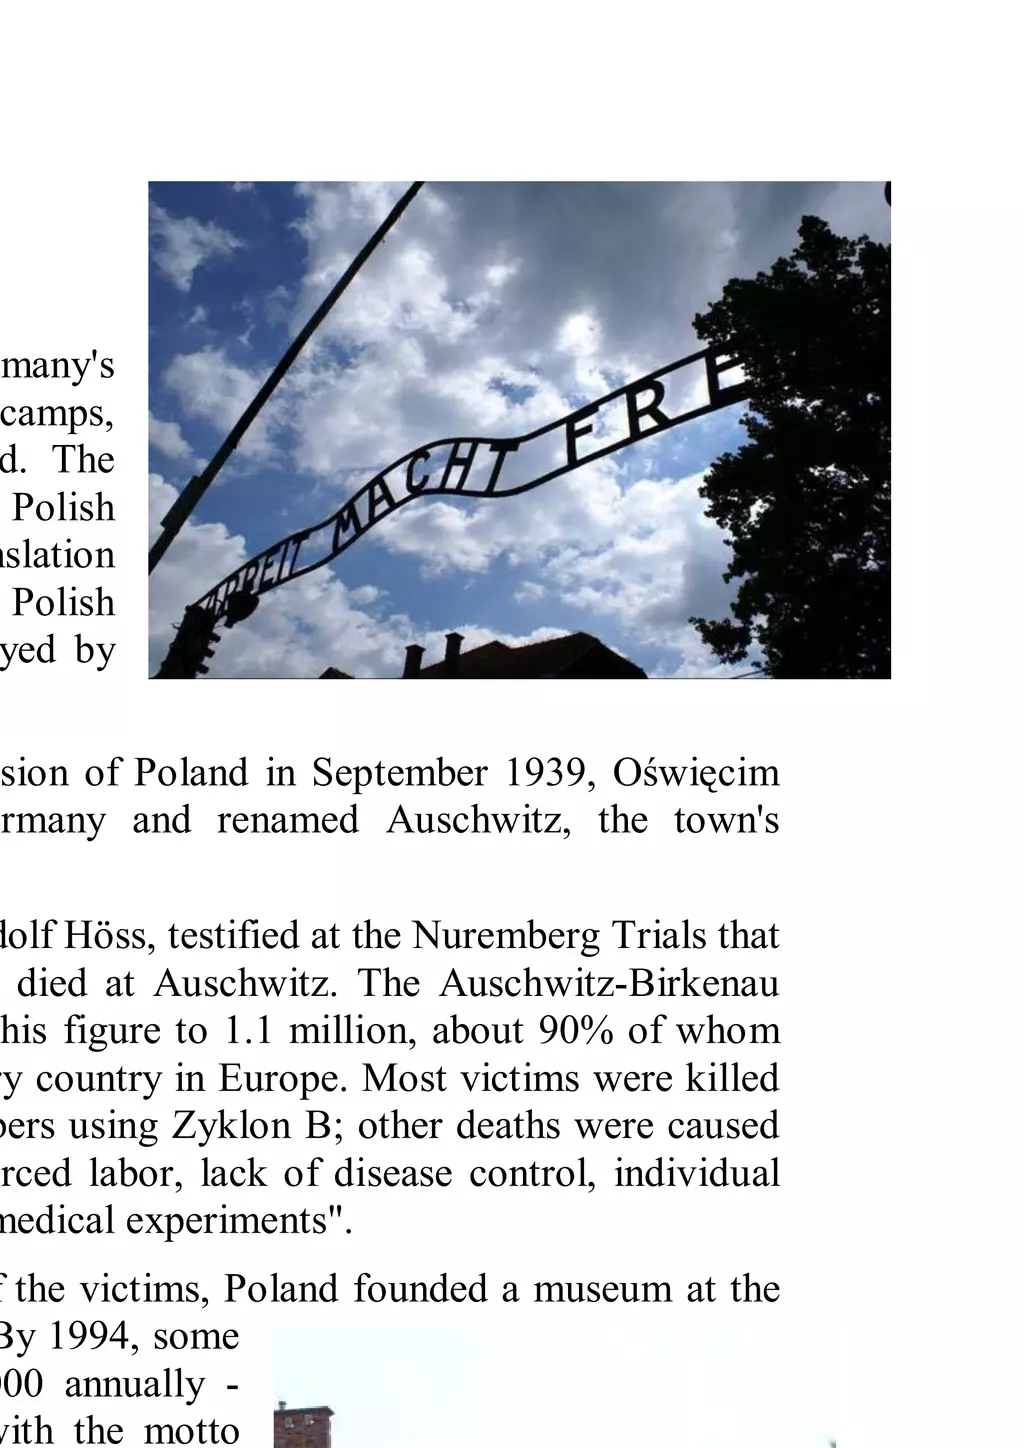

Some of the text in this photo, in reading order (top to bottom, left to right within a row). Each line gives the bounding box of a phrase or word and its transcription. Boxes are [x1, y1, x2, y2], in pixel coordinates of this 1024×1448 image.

[0, 405, 113, 435] camps,
[51, 443, 115, 474] The
[331, 437, 522, 557] MACHT
[565, 346, 752, 469] FRE
[74, 633, 117, 672] by
[85, 756, 125, 787] of
[134, 756, 249, 787] Poland
[266, 756, 297, 787] in
[313, 756, 489, 795] September
[508, 756, 596, 793] 1939,
[613, 756, 781, 794] Oświęcim
[63, 919, 155, 956] Höss,
[167, 918, 300, 950] testified
[311, 923, 341, 950] at
[351, 918, 401, 950] the
[411, 918, 601, 958] Nuremberg
[611, 918, 707, 950] Trials
[717, 918, 780, 950] that
[63, 1013, 161, 1053] figure
[175, 1018, 208, 1045] to
[227, 1014, 271, 1045] 1.1
[289, 1013, 416, 1051] million,
[432, 1013, 524, 1045] about
[539, 1014, 614, 1045] 90%
[628, 1013, 668, 1045] of
[675, 1013, 782, 1045] whom
[68, 1108, 159, 1148] using
[171, 1108, 292, 1148] Zyklon
[305, 1109, 343, 1146] B;
[358, 1108, 444, 1140] other
[456, 1108, 561, 1140] deaths
[574, 1118, 654, 1140] were
[668, 1108, 780, 1140] caused
[126, 1203, 352, 1243] experiments".
[51, 1320, 139, 1356] 1994,
[154, 1328, 240, 1350] some
[65, 1367, 206, 1406] annually
